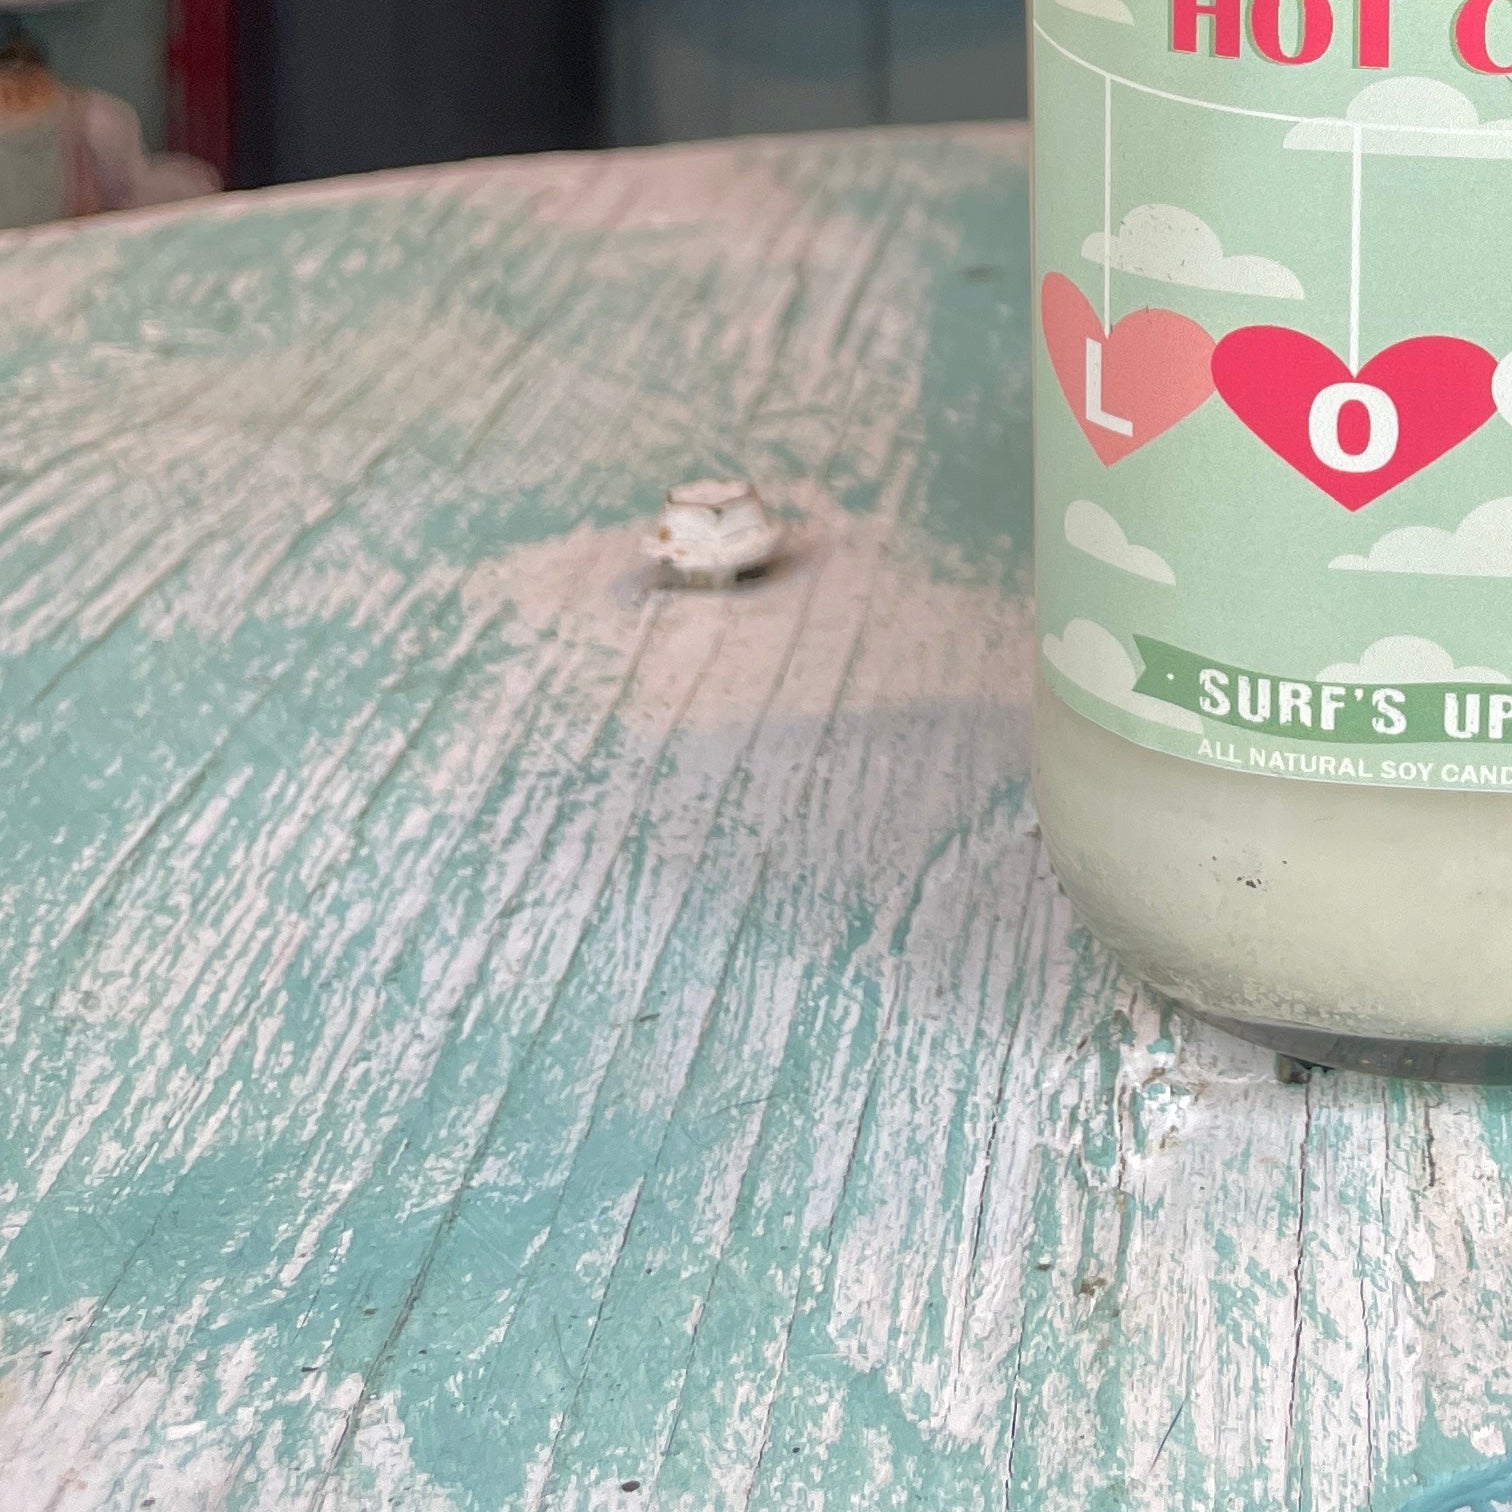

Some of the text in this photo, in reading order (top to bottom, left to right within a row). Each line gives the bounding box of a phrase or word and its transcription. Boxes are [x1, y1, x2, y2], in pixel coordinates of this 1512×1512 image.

[1198, 668, 1407, 736] SURF'S
[1197, 738, 1243, 764] ALL
[1248, 747, 1374, 779] NATURAL
[1380, 760, 1434, 781] SOY
